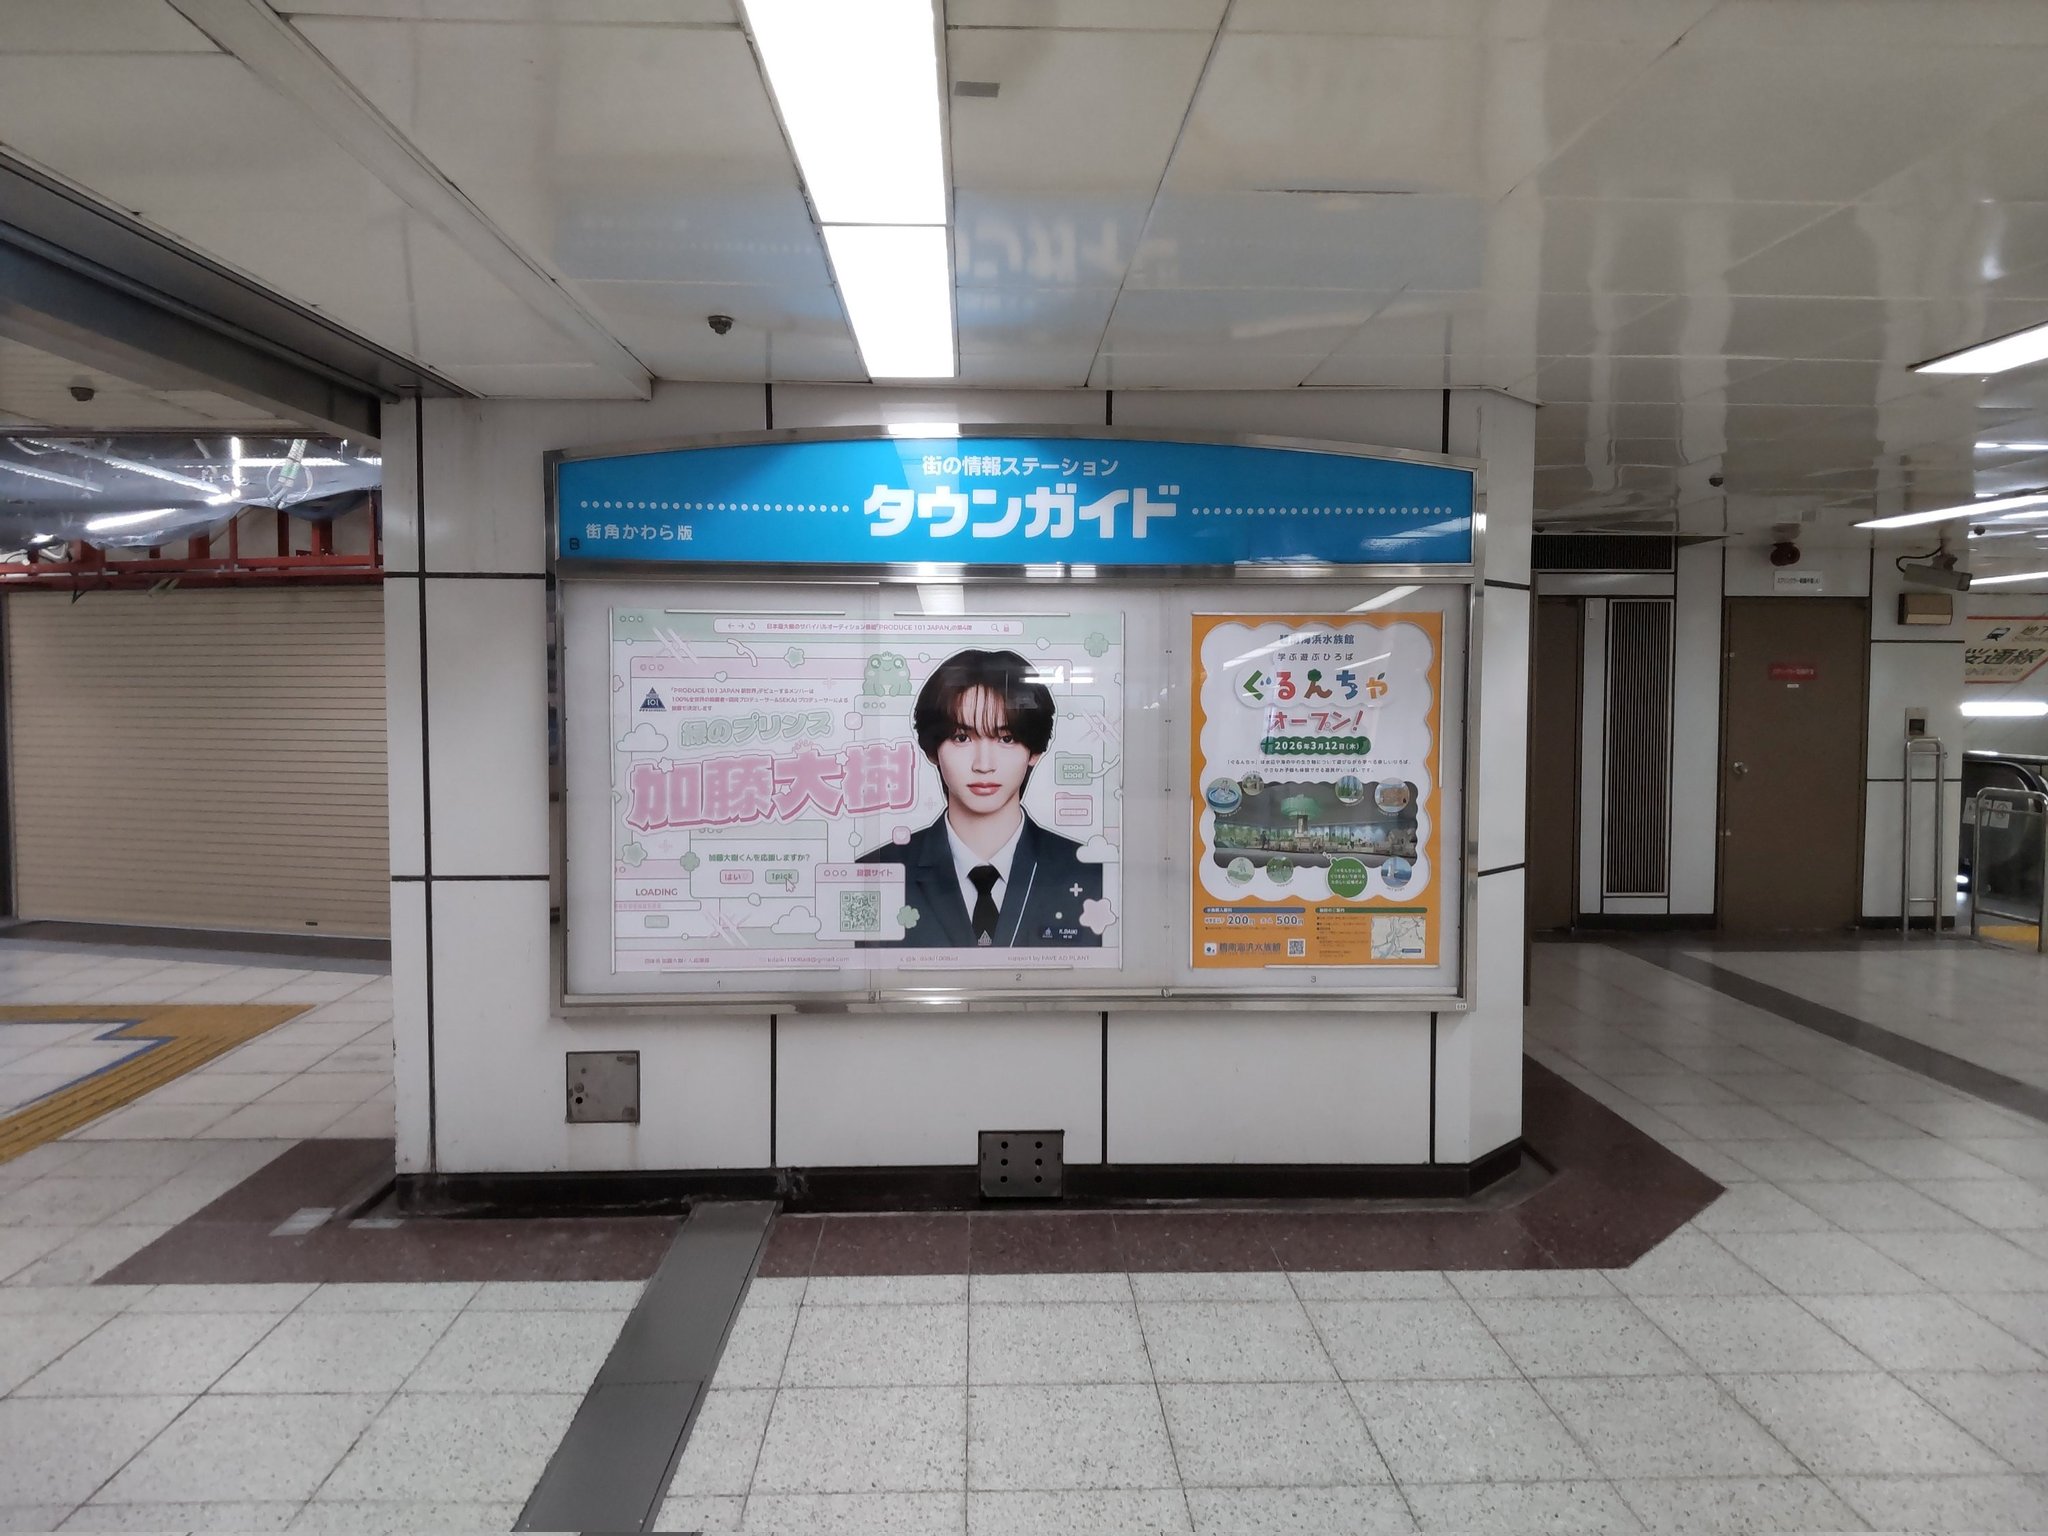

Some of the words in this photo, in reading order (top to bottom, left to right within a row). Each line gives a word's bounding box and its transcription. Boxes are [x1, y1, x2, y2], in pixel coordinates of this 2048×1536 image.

[922, 455, 1119, 476] 街の情報ステーション
[863, 483, 1181, 539] タウンガイド
[585, 523, 693, 541] 街角かわら版
[570, 538, 580, 550] B
[1278, 652, 1354, 661] 学ぶ遊ぶひろば
[1243, 668, 1389, 701] ぐるんちゃ
[680, 711, 832, 747] 緑のプリンス
[1268, 709, 1364, 734] オープン!
[627, 742, 917, 831] 加藤大樹
[635, 887, 678, 897] LOADING
[717, 980, 722, 988] 1
[1015, 973, 1022, 981] 2
[1310, 975, 1317, 983] 3
